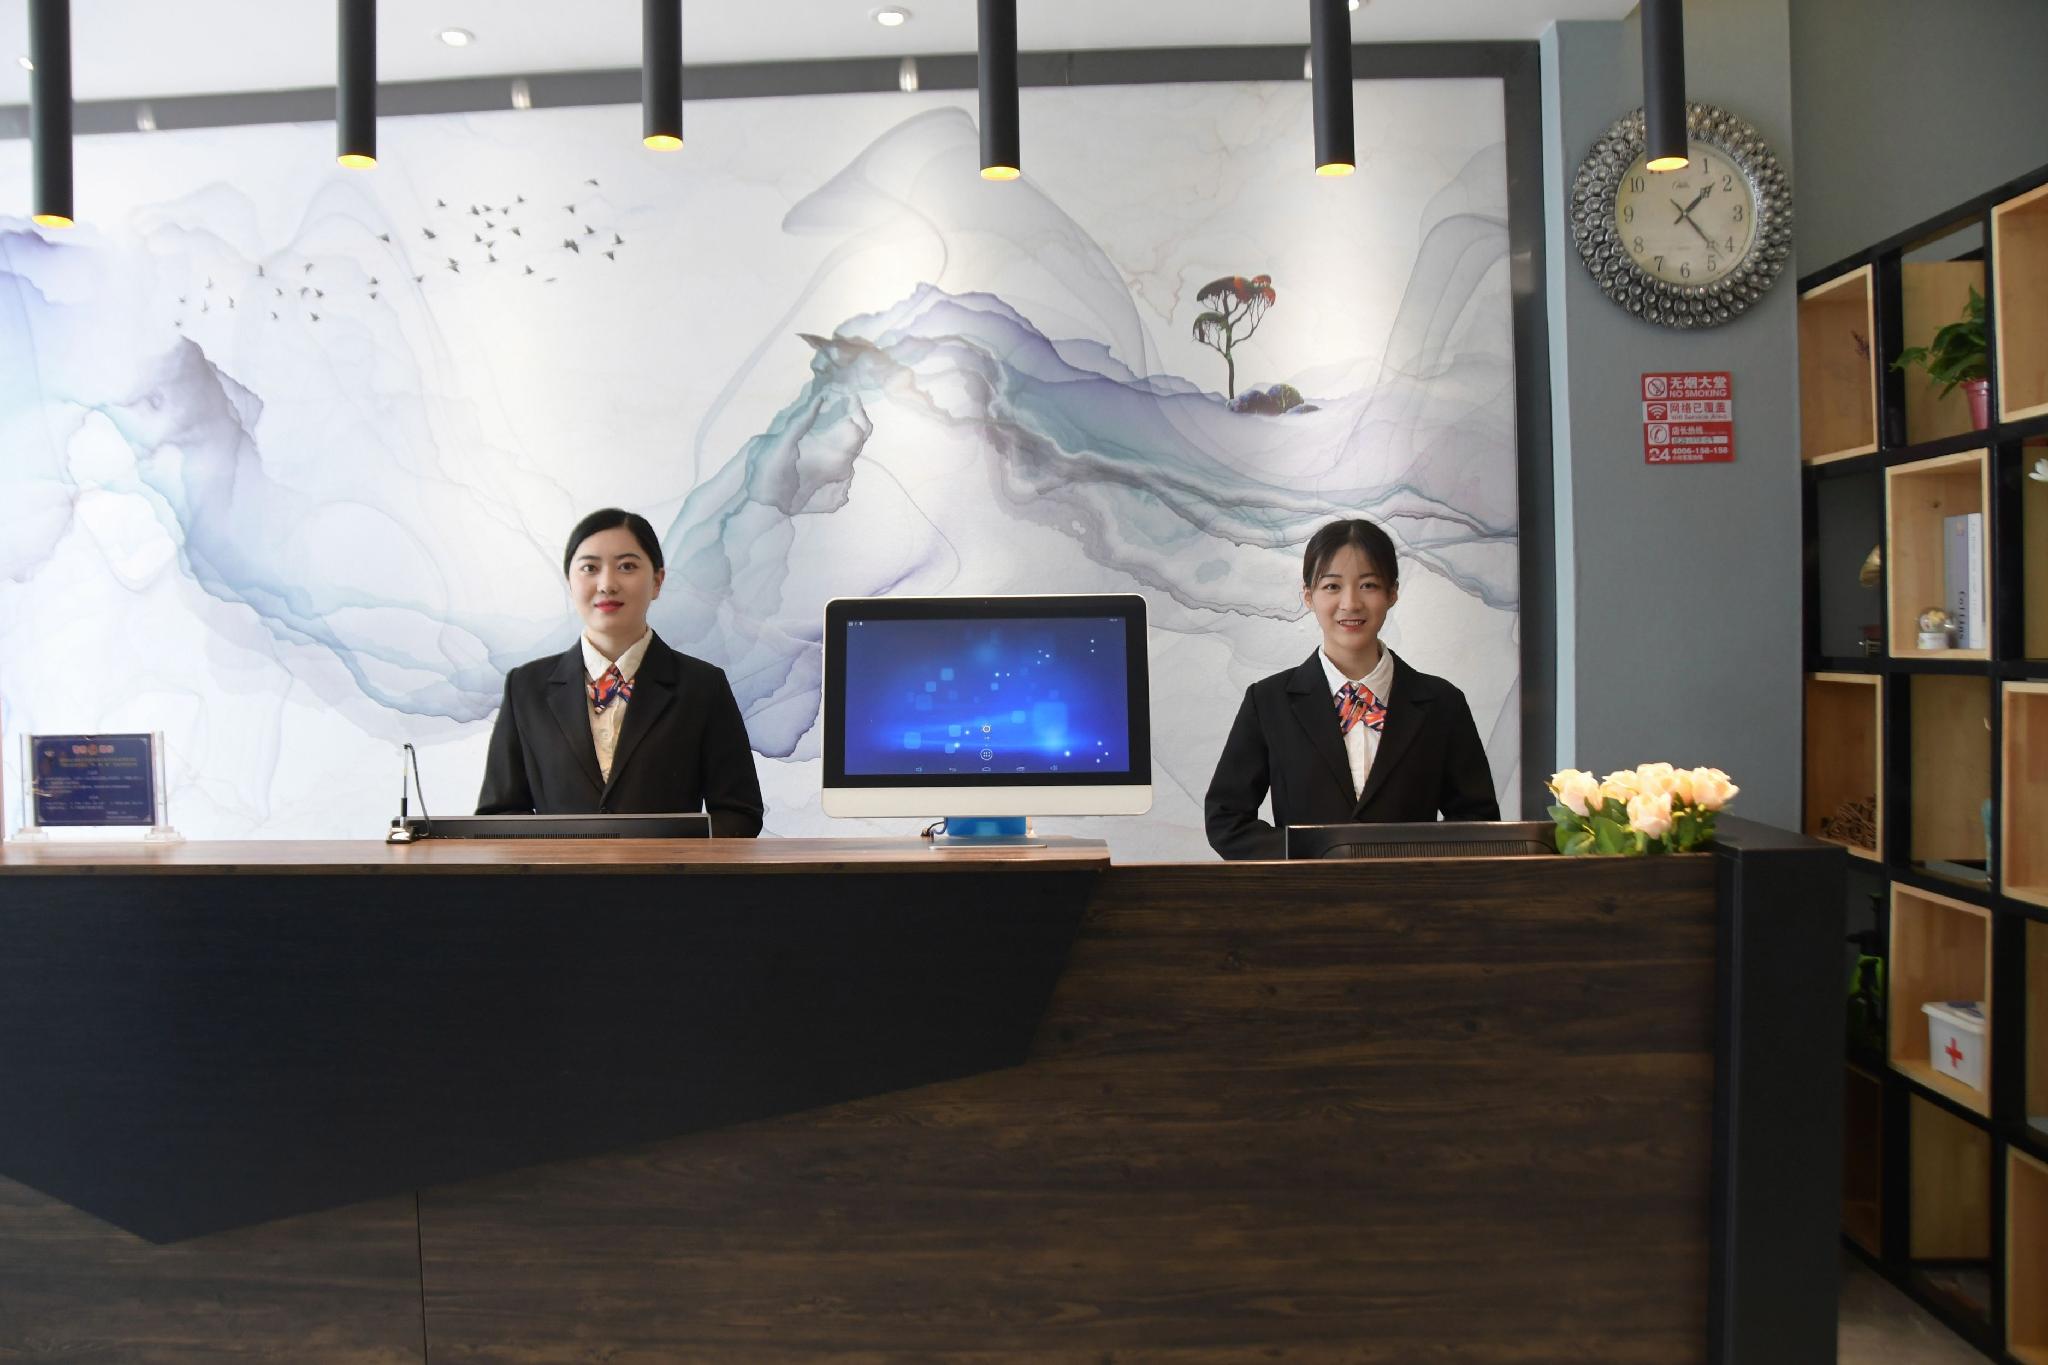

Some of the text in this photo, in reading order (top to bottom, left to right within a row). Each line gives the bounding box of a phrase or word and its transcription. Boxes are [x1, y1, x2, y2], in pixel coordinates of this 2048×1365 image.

[1703, 158, 1709, 173] 1
[1630, 176, 1645, 193] 10
[1722, 175, 1732, 192] 2
[1624, 205, 1634, 224] 9
[1733, 205, 1743, 222] 3
[1633, 236, 1644, 254] 8
[1724, 236, 1734, 253] 4
[1654, 256, 1664, 272] 7
[1680, 263, 1690, 279] 6
[1707, 255, 1717, 272] 5
[1670, 376, 1727, 389] 无烟大堂
[1670, 389, 1727, 398] NO SMOKING
[1649, 448, 1671, 461] 24
